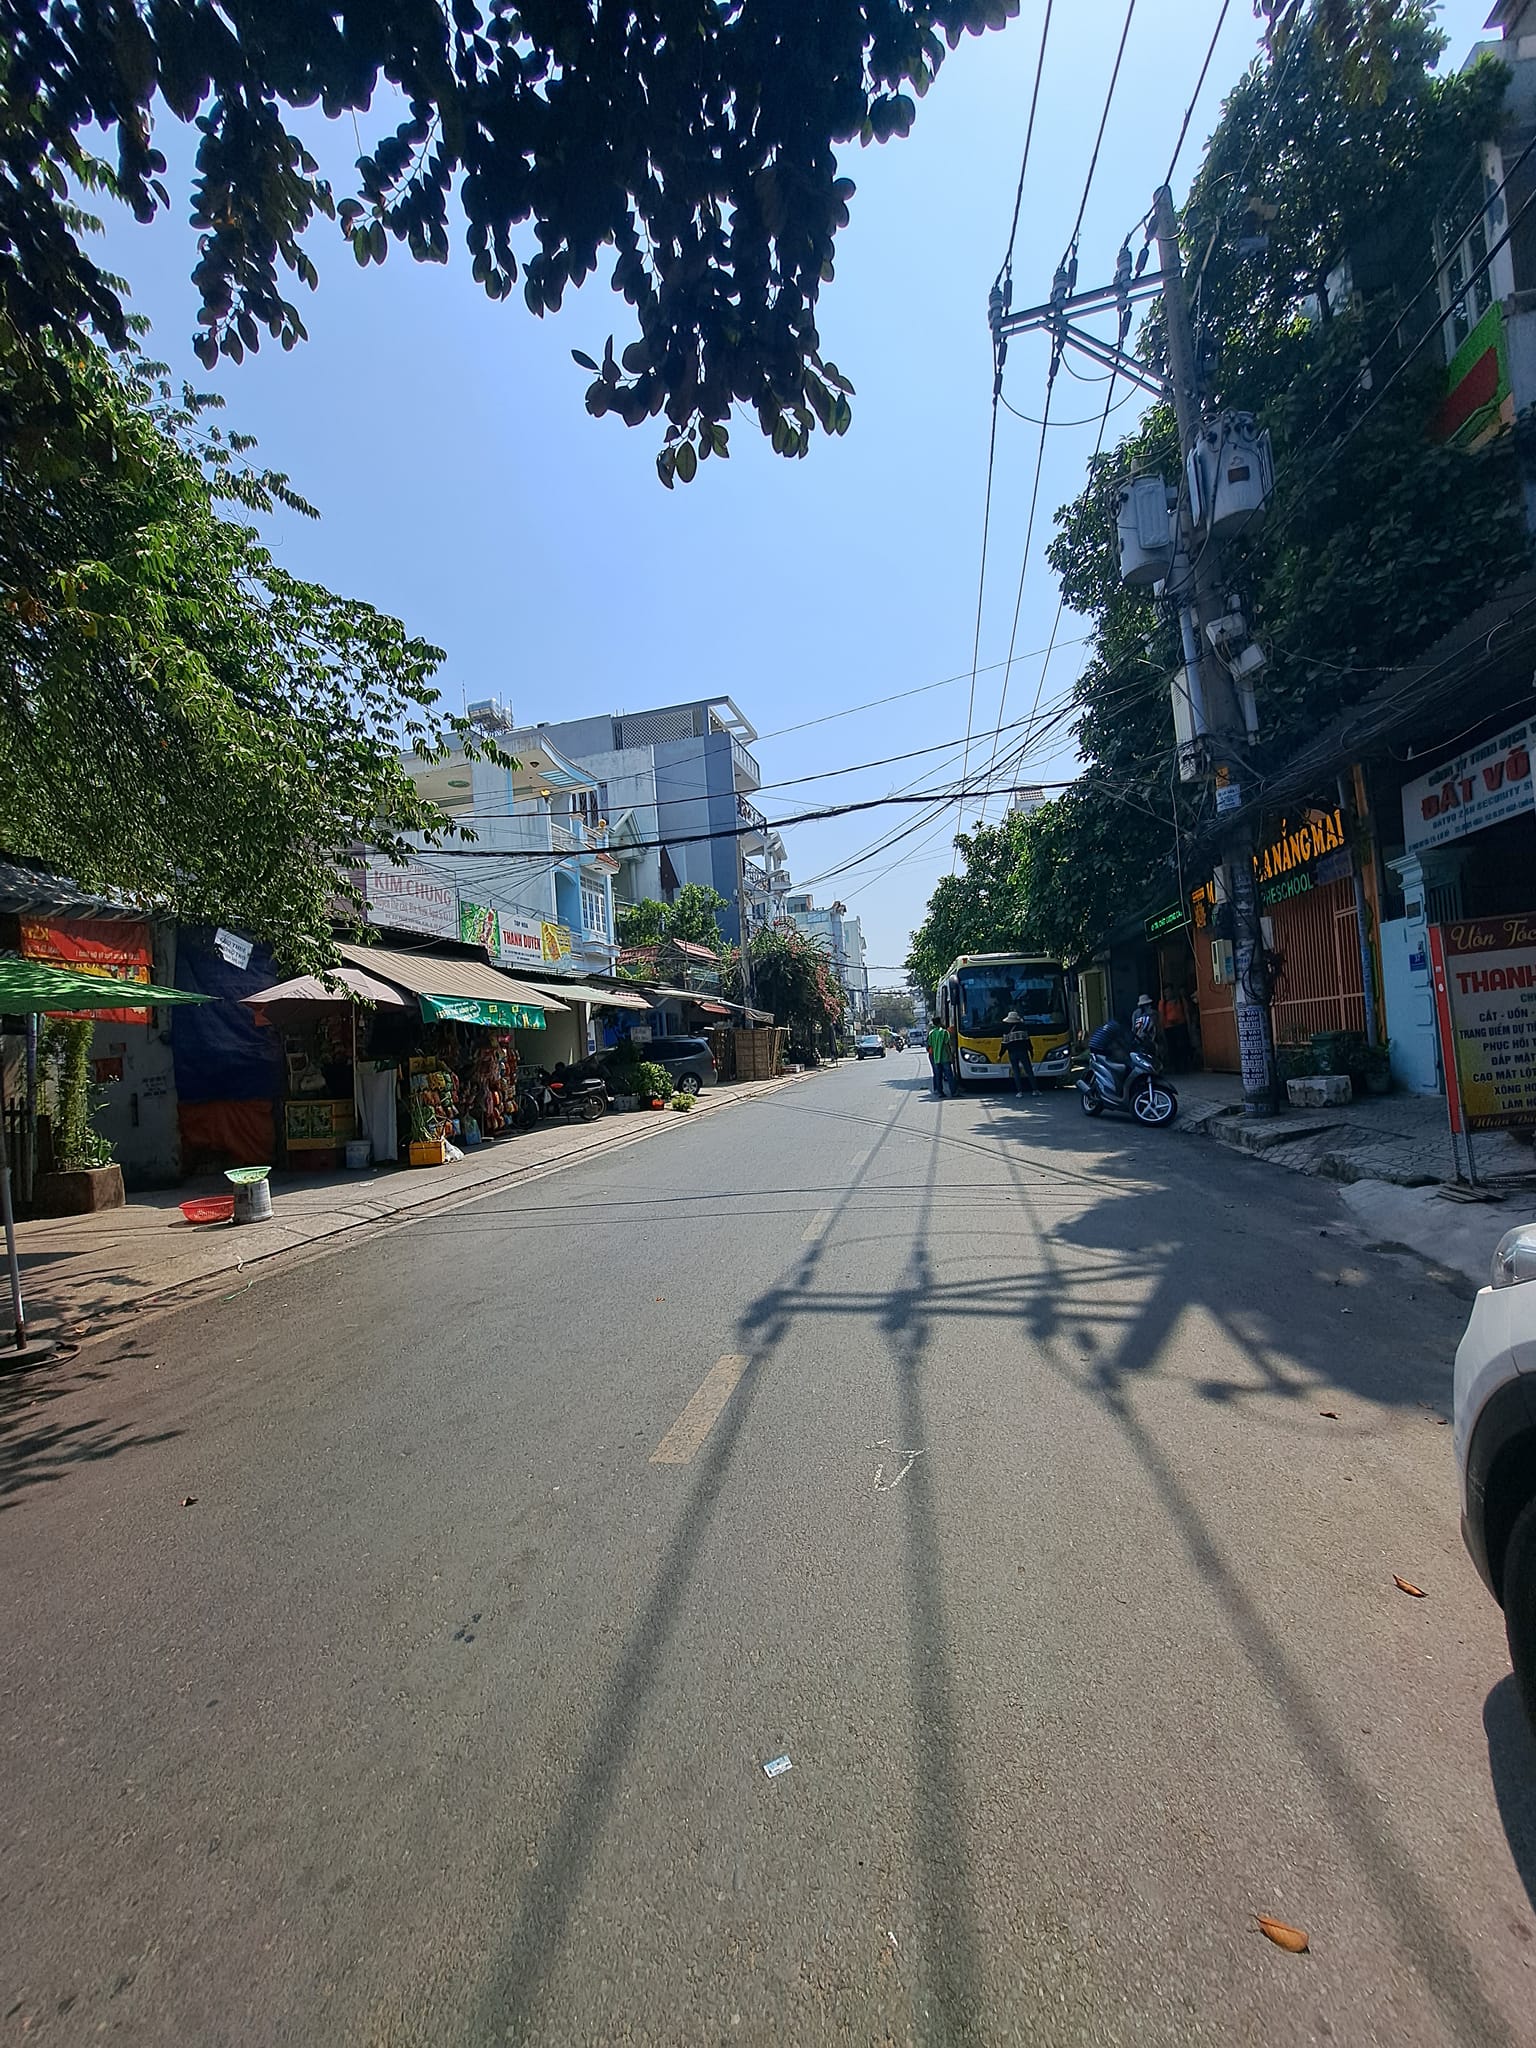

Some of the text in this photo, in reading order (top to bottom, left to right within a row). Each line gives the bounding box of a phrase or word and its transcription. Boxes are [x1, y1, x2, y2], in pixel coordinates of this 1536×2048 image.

[374, 870, 452, 906] KIM CHUNG
[1450, 925, 1497, 951] Uốn
